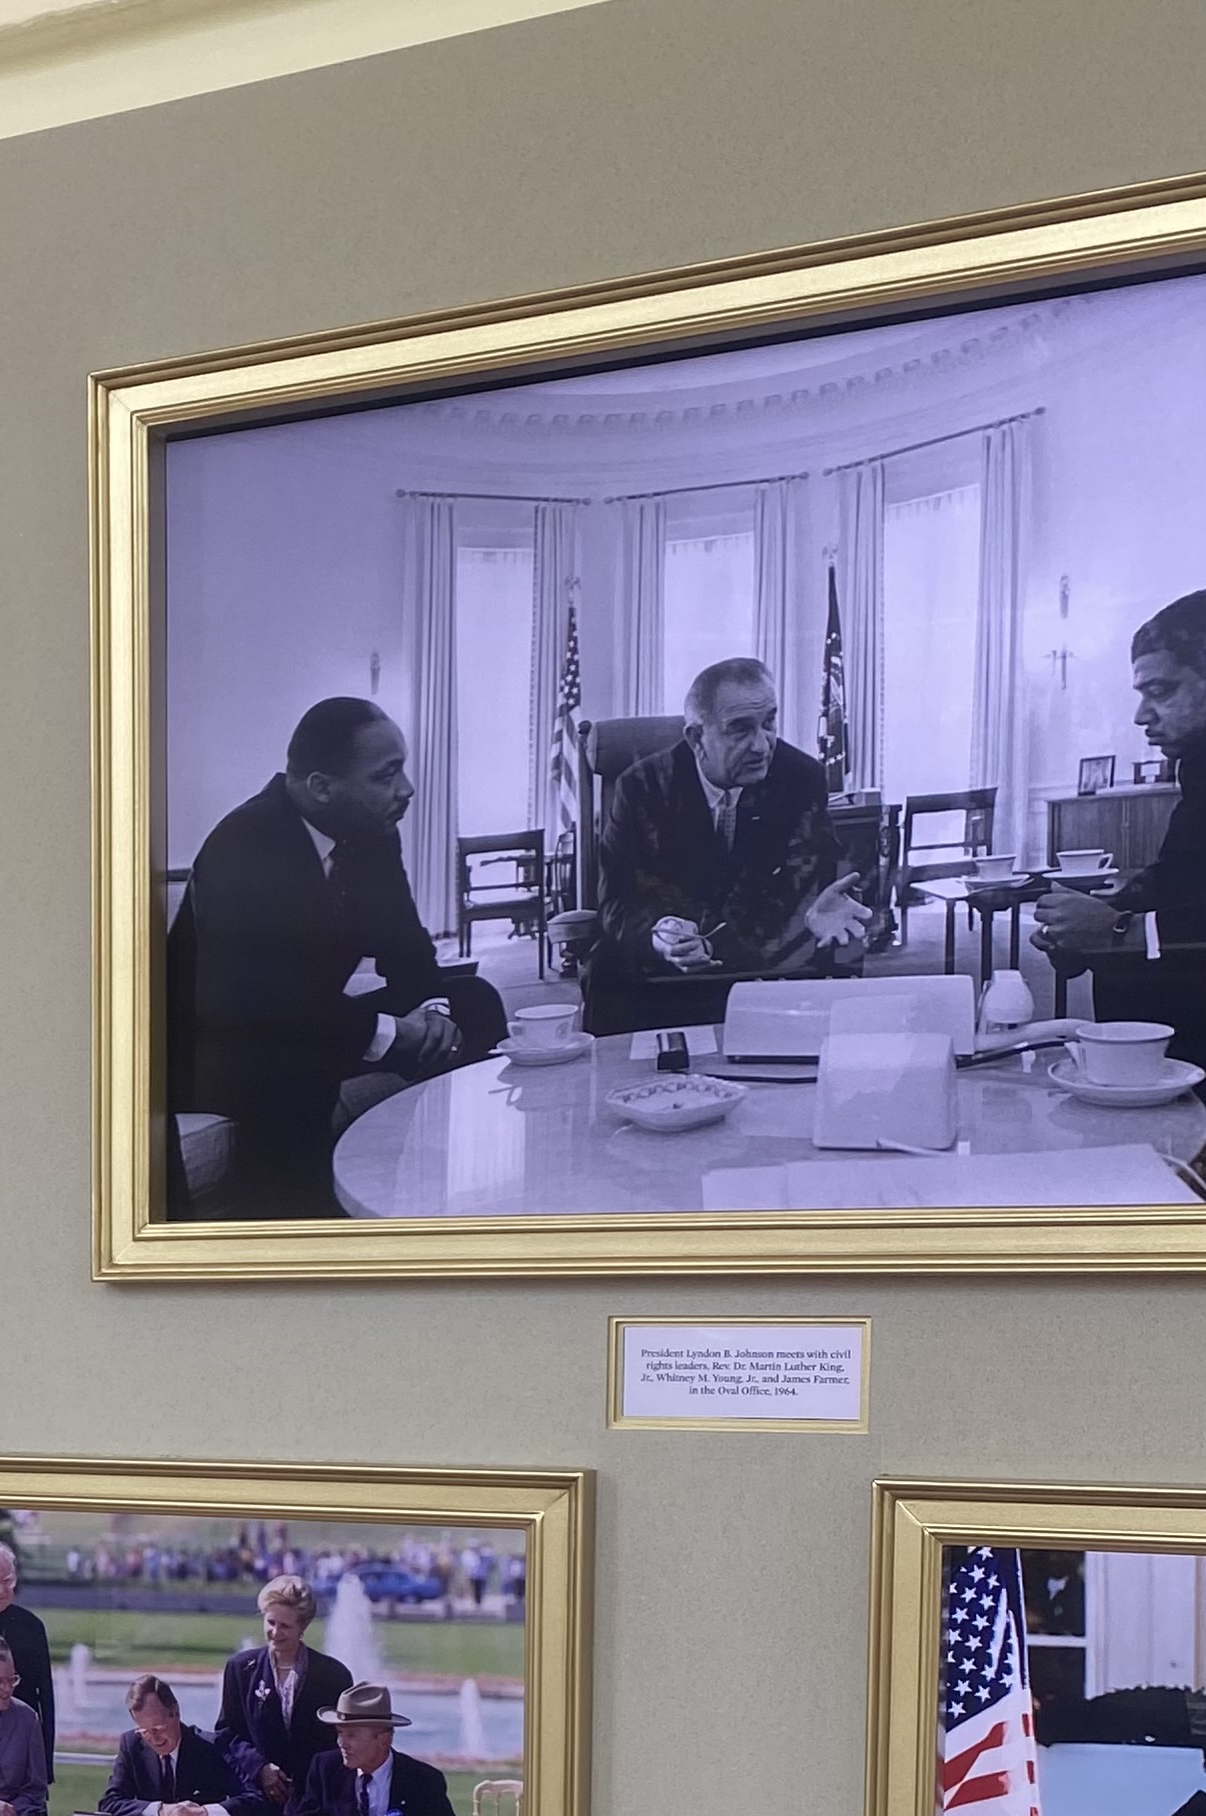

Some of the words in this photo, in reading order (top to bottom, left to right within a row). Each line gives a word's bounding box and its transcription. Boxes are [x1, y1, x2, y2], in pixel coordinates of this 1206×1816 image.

[641, 1349, 684, 1359] President
[686, 1349, 721, 1360] Lyndon
[724, 1350, 732, 1358] B.
[734, 1349, 774, 1359] Johnson
[776, 1351, 804, 1359] meets
[806, 1350, 828, 1360] with
[830, 1350, 851, 1360] civil
[646, 1361, 672, 1372] rights
[749, 1362, 781, 1371] Martin
[784, 1362, 817, 1372] Luther
[819, 1362, 845, 1373] King,
[656, 1373, 695, 1384] Whitney
[698, 1374, 710, 1382] M.
[713, 1374, 743, 1384] Young,
[761, 1374, 779, 1383] and
[781, 1374, 811, 1384] James
[813, 1375, 849, 1385] Farmer,
[689, 1386, 699, 1395] in
[700, 1386, 715, 1395] the
[718, 1386, 739, 1395] Oval
[741, 1386, 772, 1397] Office,
[774, 1387, 798, 1396] 1964.
